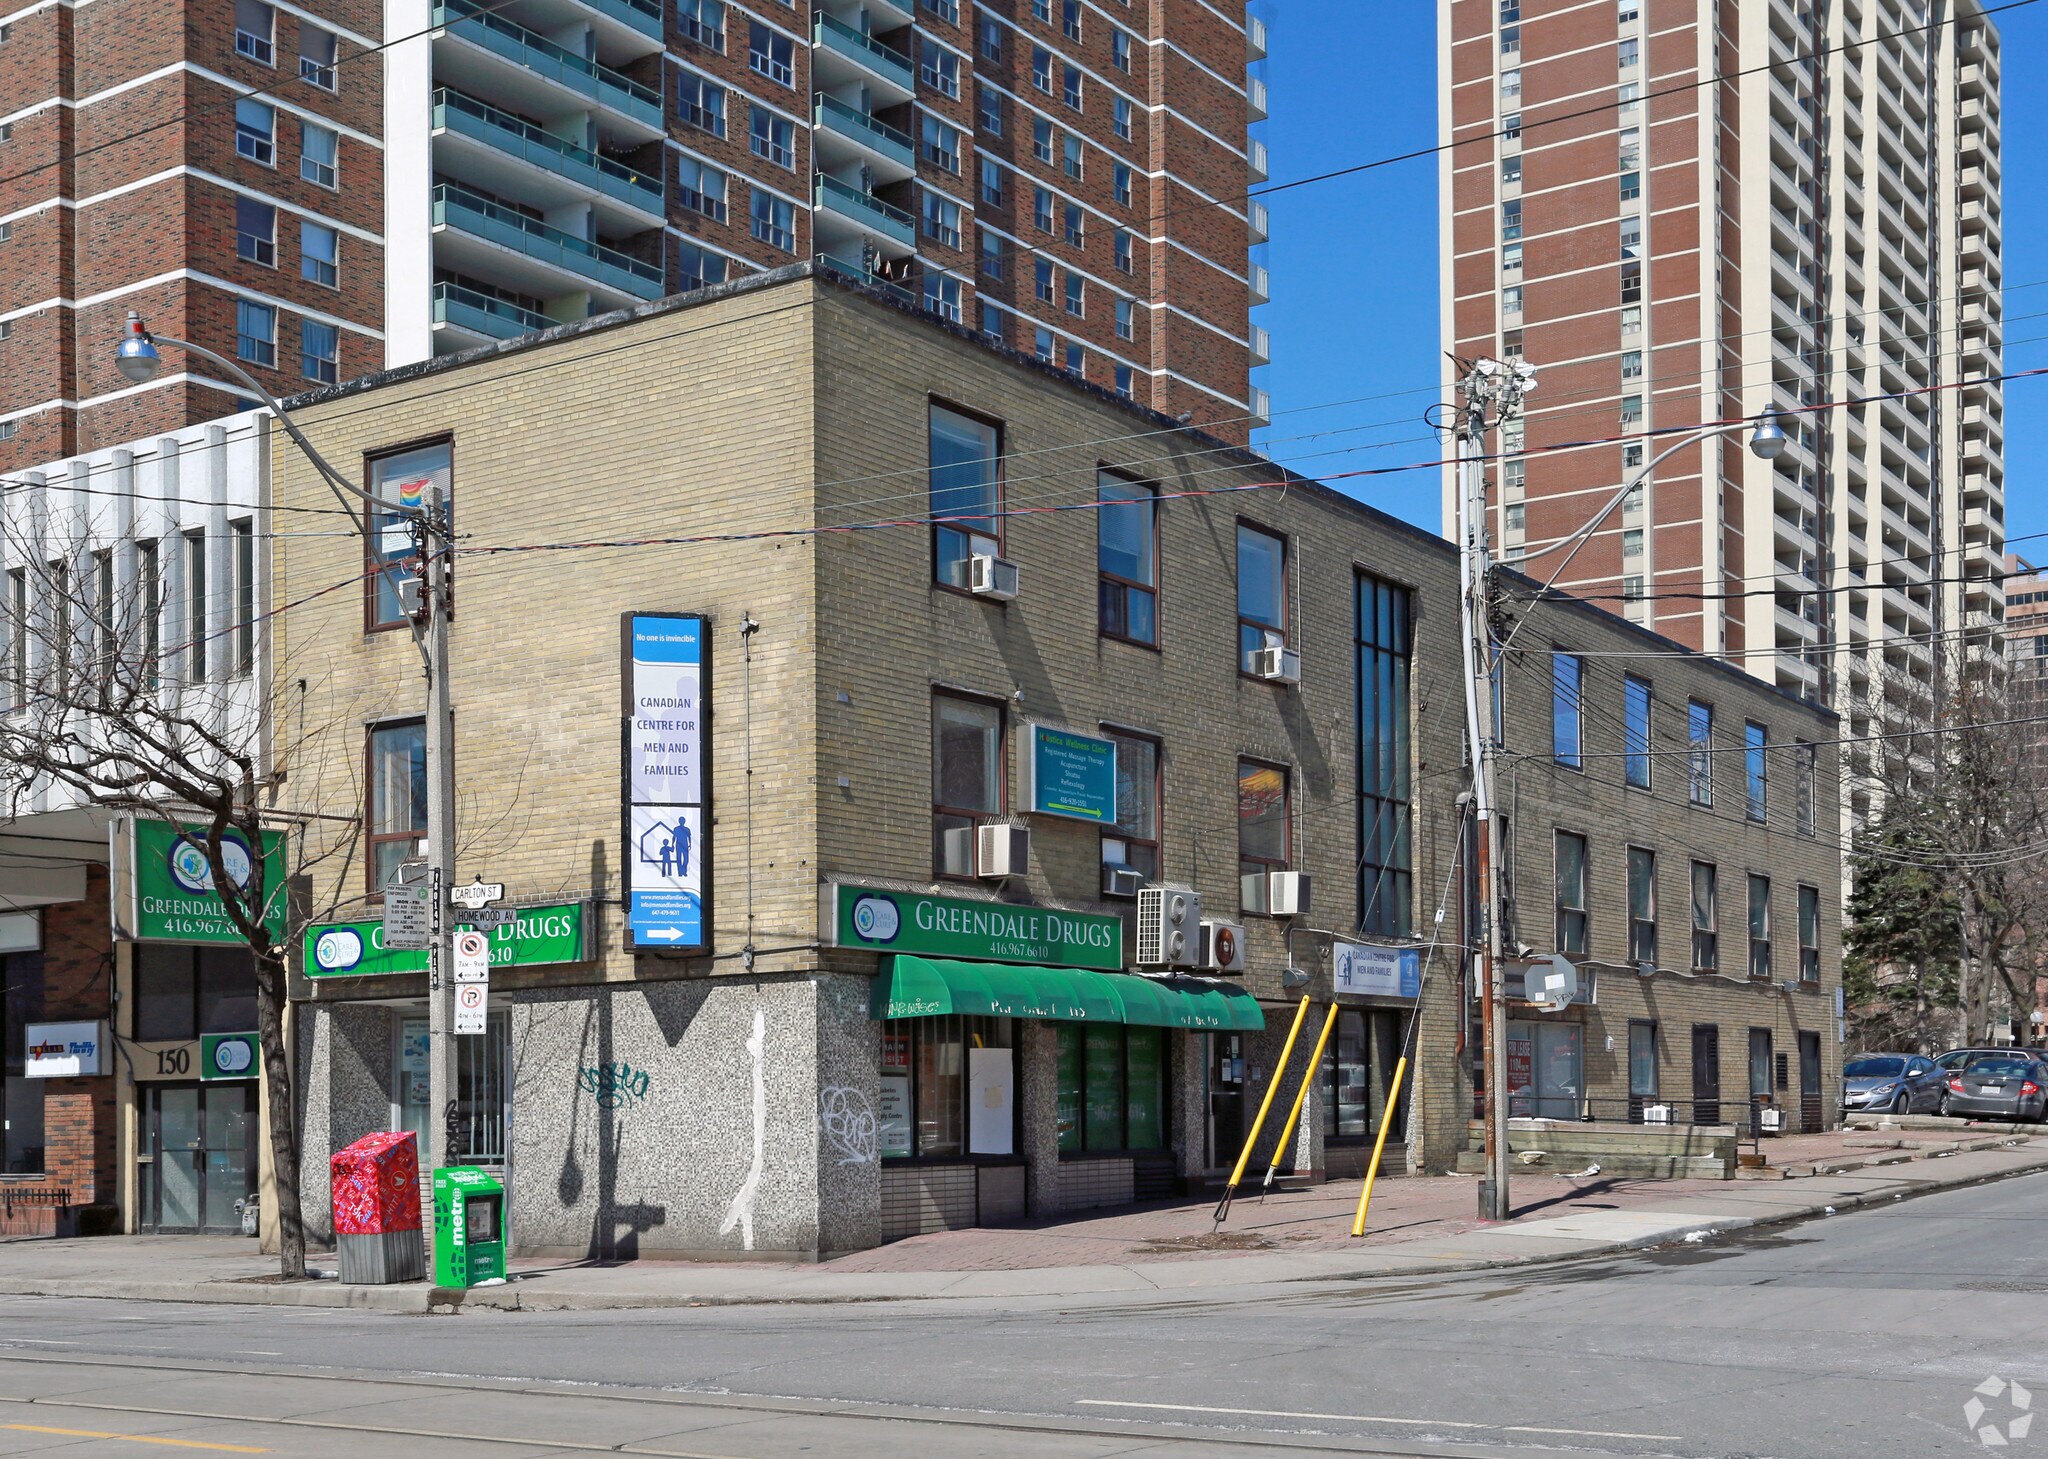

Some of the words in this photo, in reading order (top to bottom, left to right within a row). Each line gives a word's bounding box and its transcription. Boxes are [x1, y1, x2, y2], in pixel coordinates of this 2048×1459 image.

[666, 634, 696, 643] invincible
[640, 697, 691, 708] CANADIAN
[637, 720, 673, 730] CENTRE
[676, 721, 695, 731] FOR
[644, 742, 665, 752] MEN
[668, 743, 688, 753] AND
[1045, 746, 1066, 757] Registered
[1068, 752, 1086, 762] Massage
[1088, 756, 1104, 766] Therapy
[644, 765, 688, 775] FAMILIES
[1061, 760, 1087, 770] Acupuncture
[1061, 778, 1085, 790] Reflexology
[455, 887, 486, 899] CARLTON
[143, 896, 227, 917] GREENDALE
[458, 911, 500, 921] HOMEWOOD
[497, 916, 571, 941] DRUGS
[915, 901, 1039, 941] GREENDALE
[1046, 915, 1111, 948] DRUGS
[990, 942, 1049, 958] 416.967.6610
[1353, 951, 1372, 960] CANADIAN
[1373, 953, 1386, 962] CENTRE
[1357, 966, 1366, 974] MEN
[1508, 1041, 1516, 1056] FOR
[1518, 1041, 1530, 1056] LEASE
[156, 1049, 190, 1074] 150
